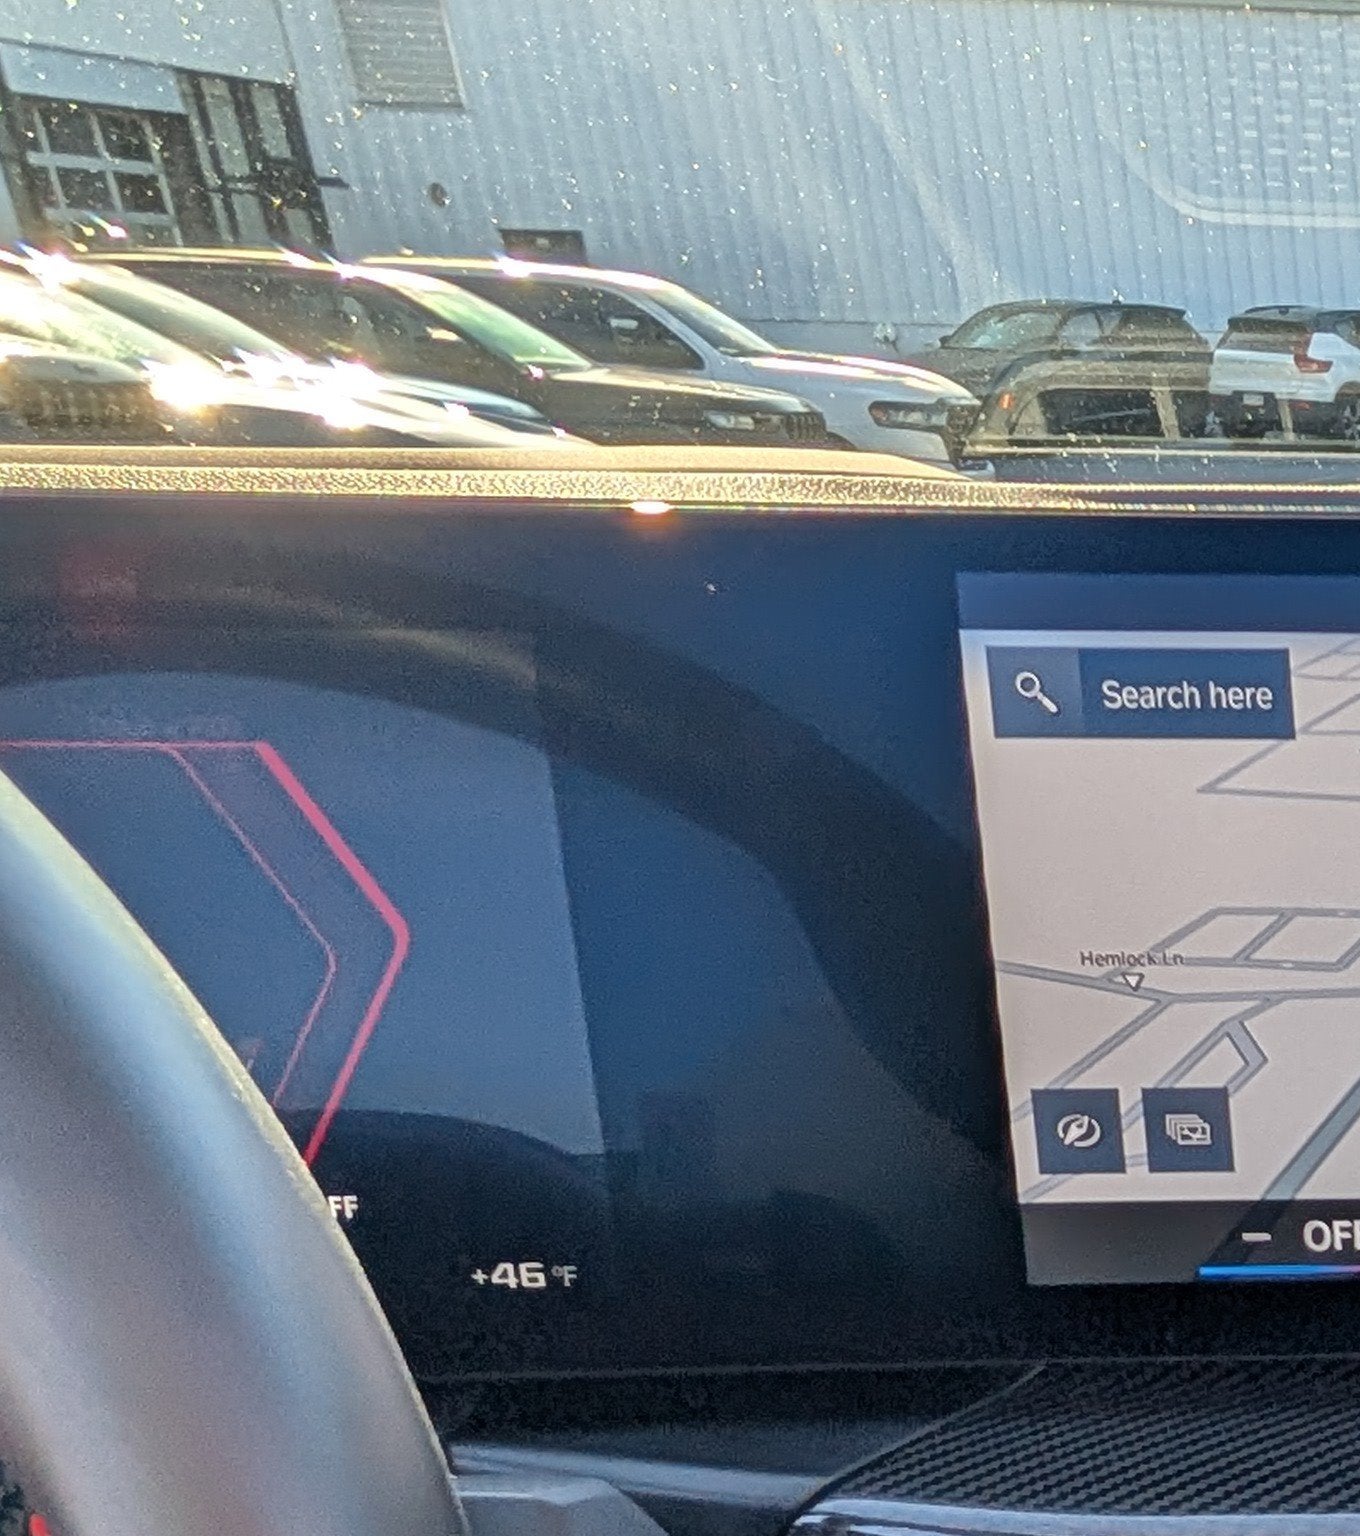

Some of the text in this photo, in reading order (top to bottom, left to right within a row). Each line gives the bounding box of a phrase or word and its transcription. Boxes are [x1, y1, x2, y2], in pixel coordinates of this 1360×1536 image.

[1101, 680, 1274, 710] Search here
[1080, 951, 1185, 967] Hemlock Ln
